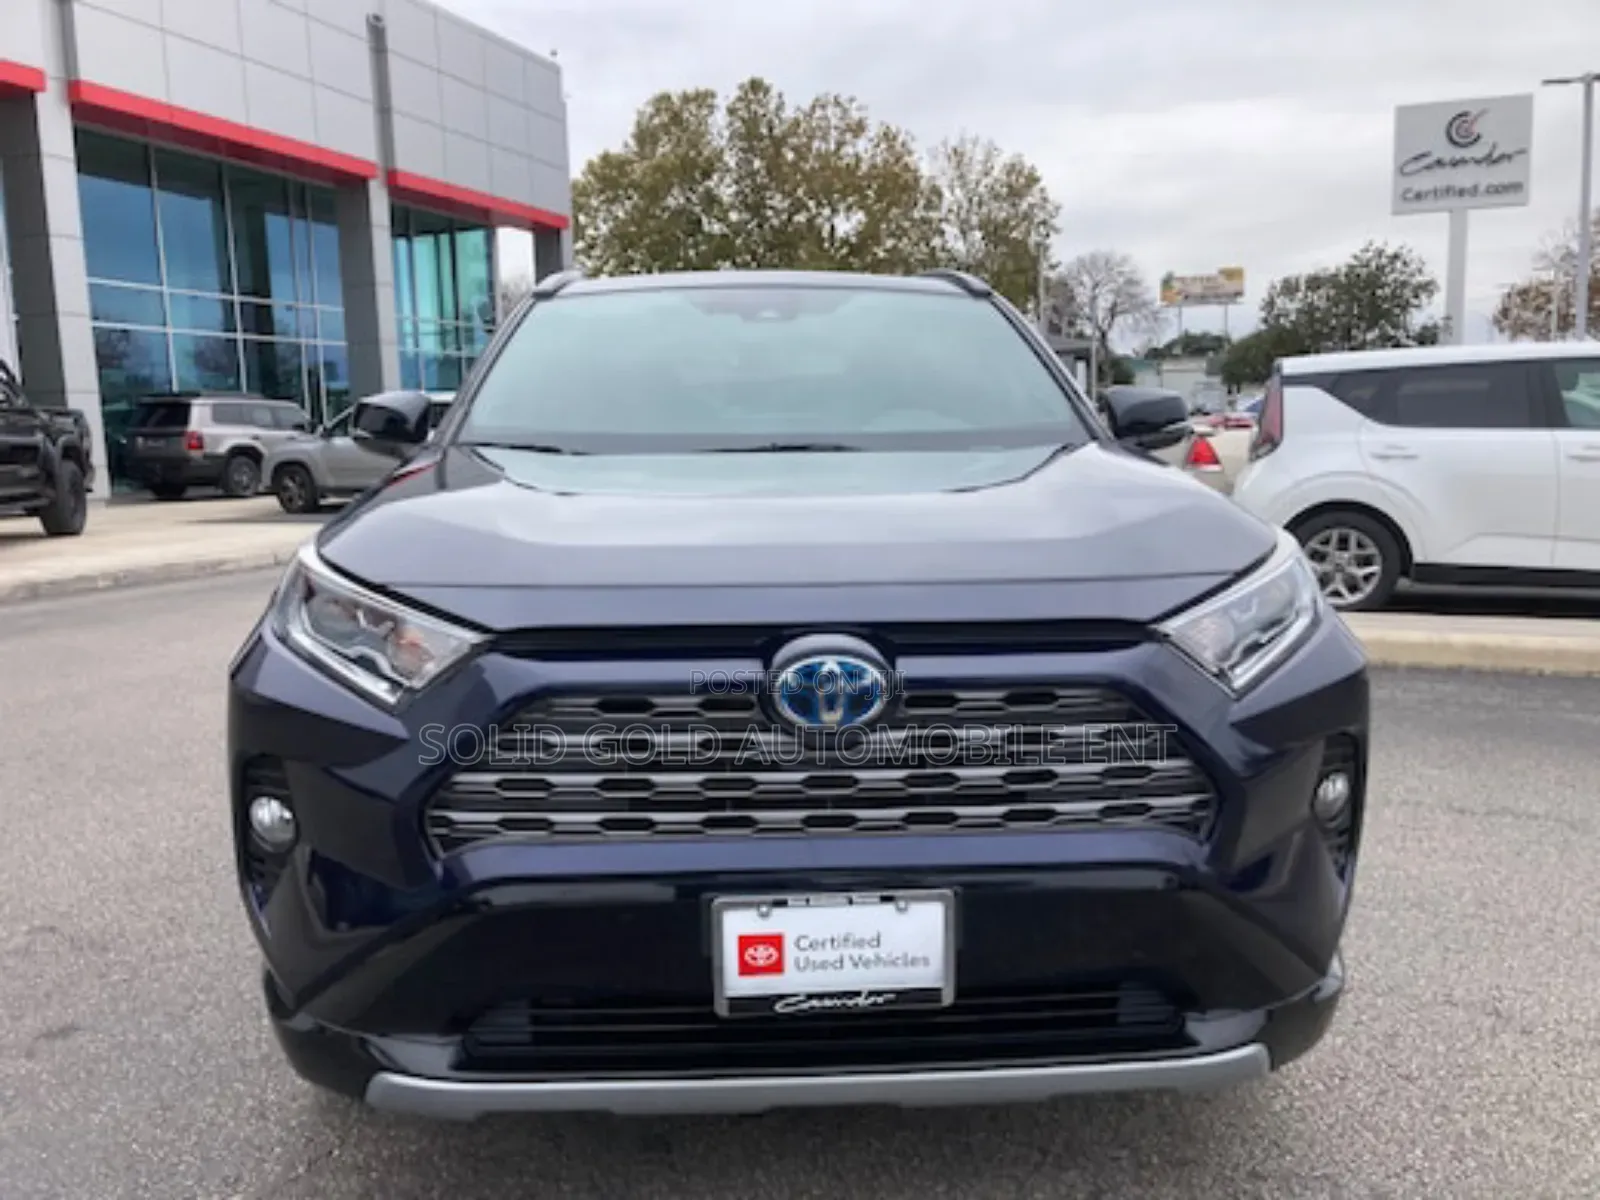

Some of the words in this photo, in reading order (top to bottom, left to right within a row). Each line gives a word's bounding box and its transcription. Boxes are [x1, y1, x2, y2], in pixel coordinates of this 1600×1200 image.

[1401, 182, 1524, 202] Certified.com
[794, 931, 881, 951] Certified
[794, 954, 845, 973] Used
[851, 951, 931, 970] Vehicles
